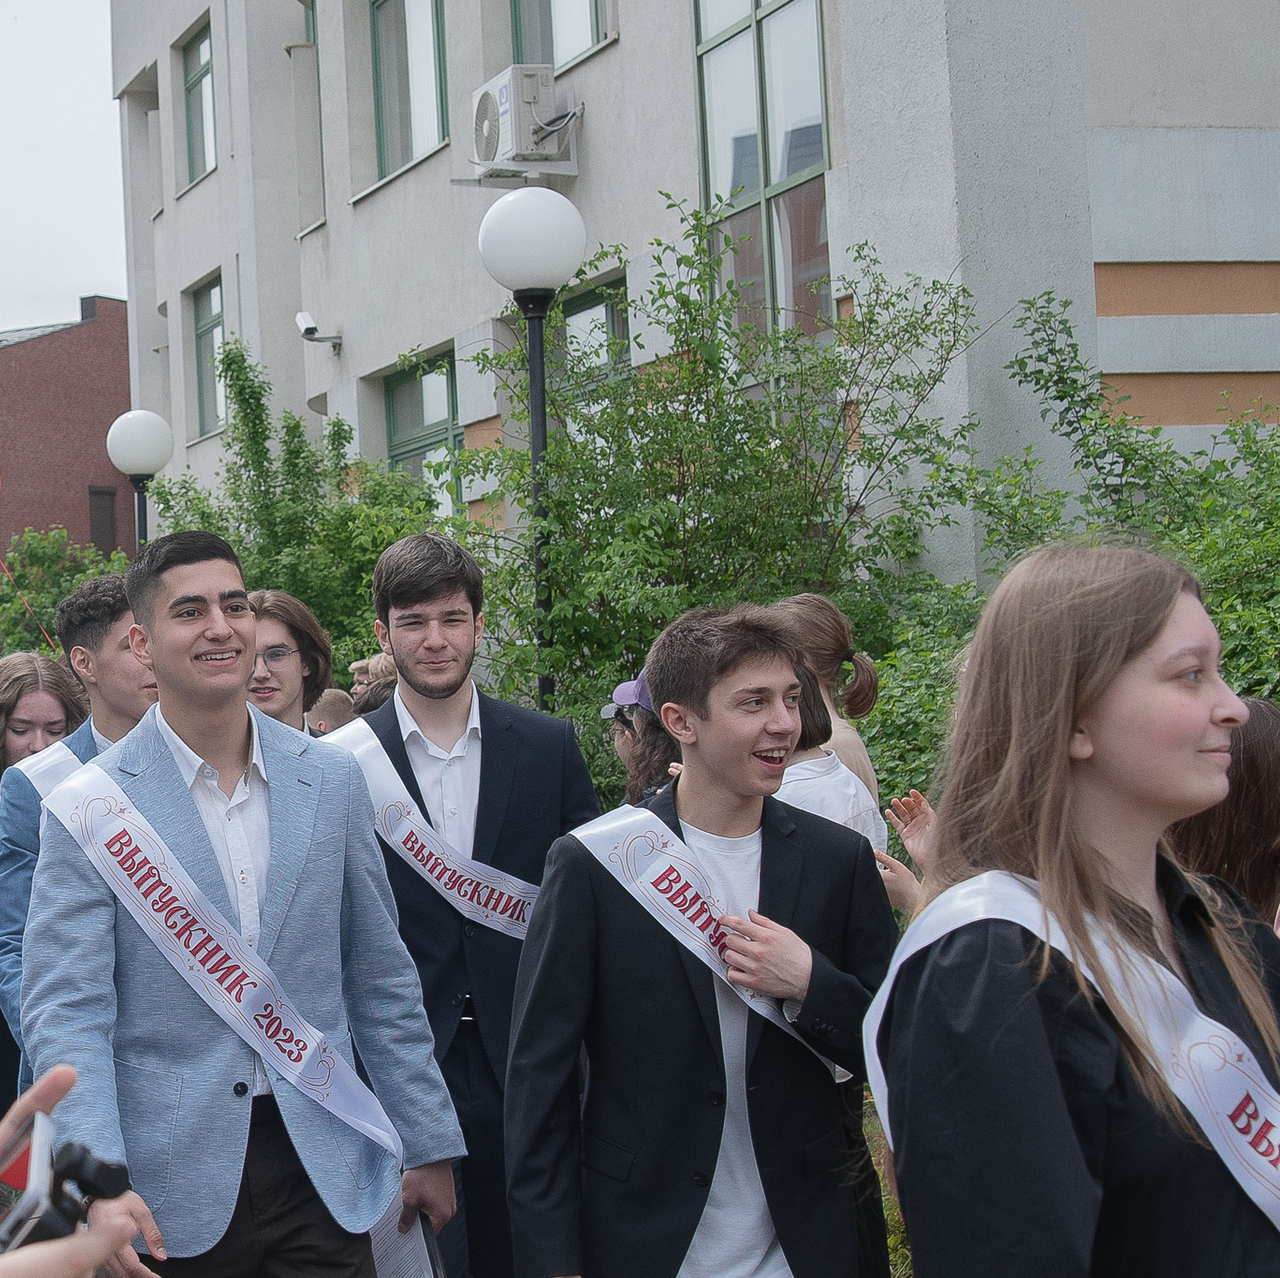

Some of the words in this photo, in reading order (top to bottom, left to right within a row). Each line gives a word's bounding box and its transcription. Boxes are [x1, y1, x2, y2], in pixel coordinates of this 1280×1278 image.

[104, 828, 258, 1003] ВЫПУСКНИК
[253, 1003, 309, 1064] 2023
[401, 829, 531, 923] ВЫПУСКНИК
